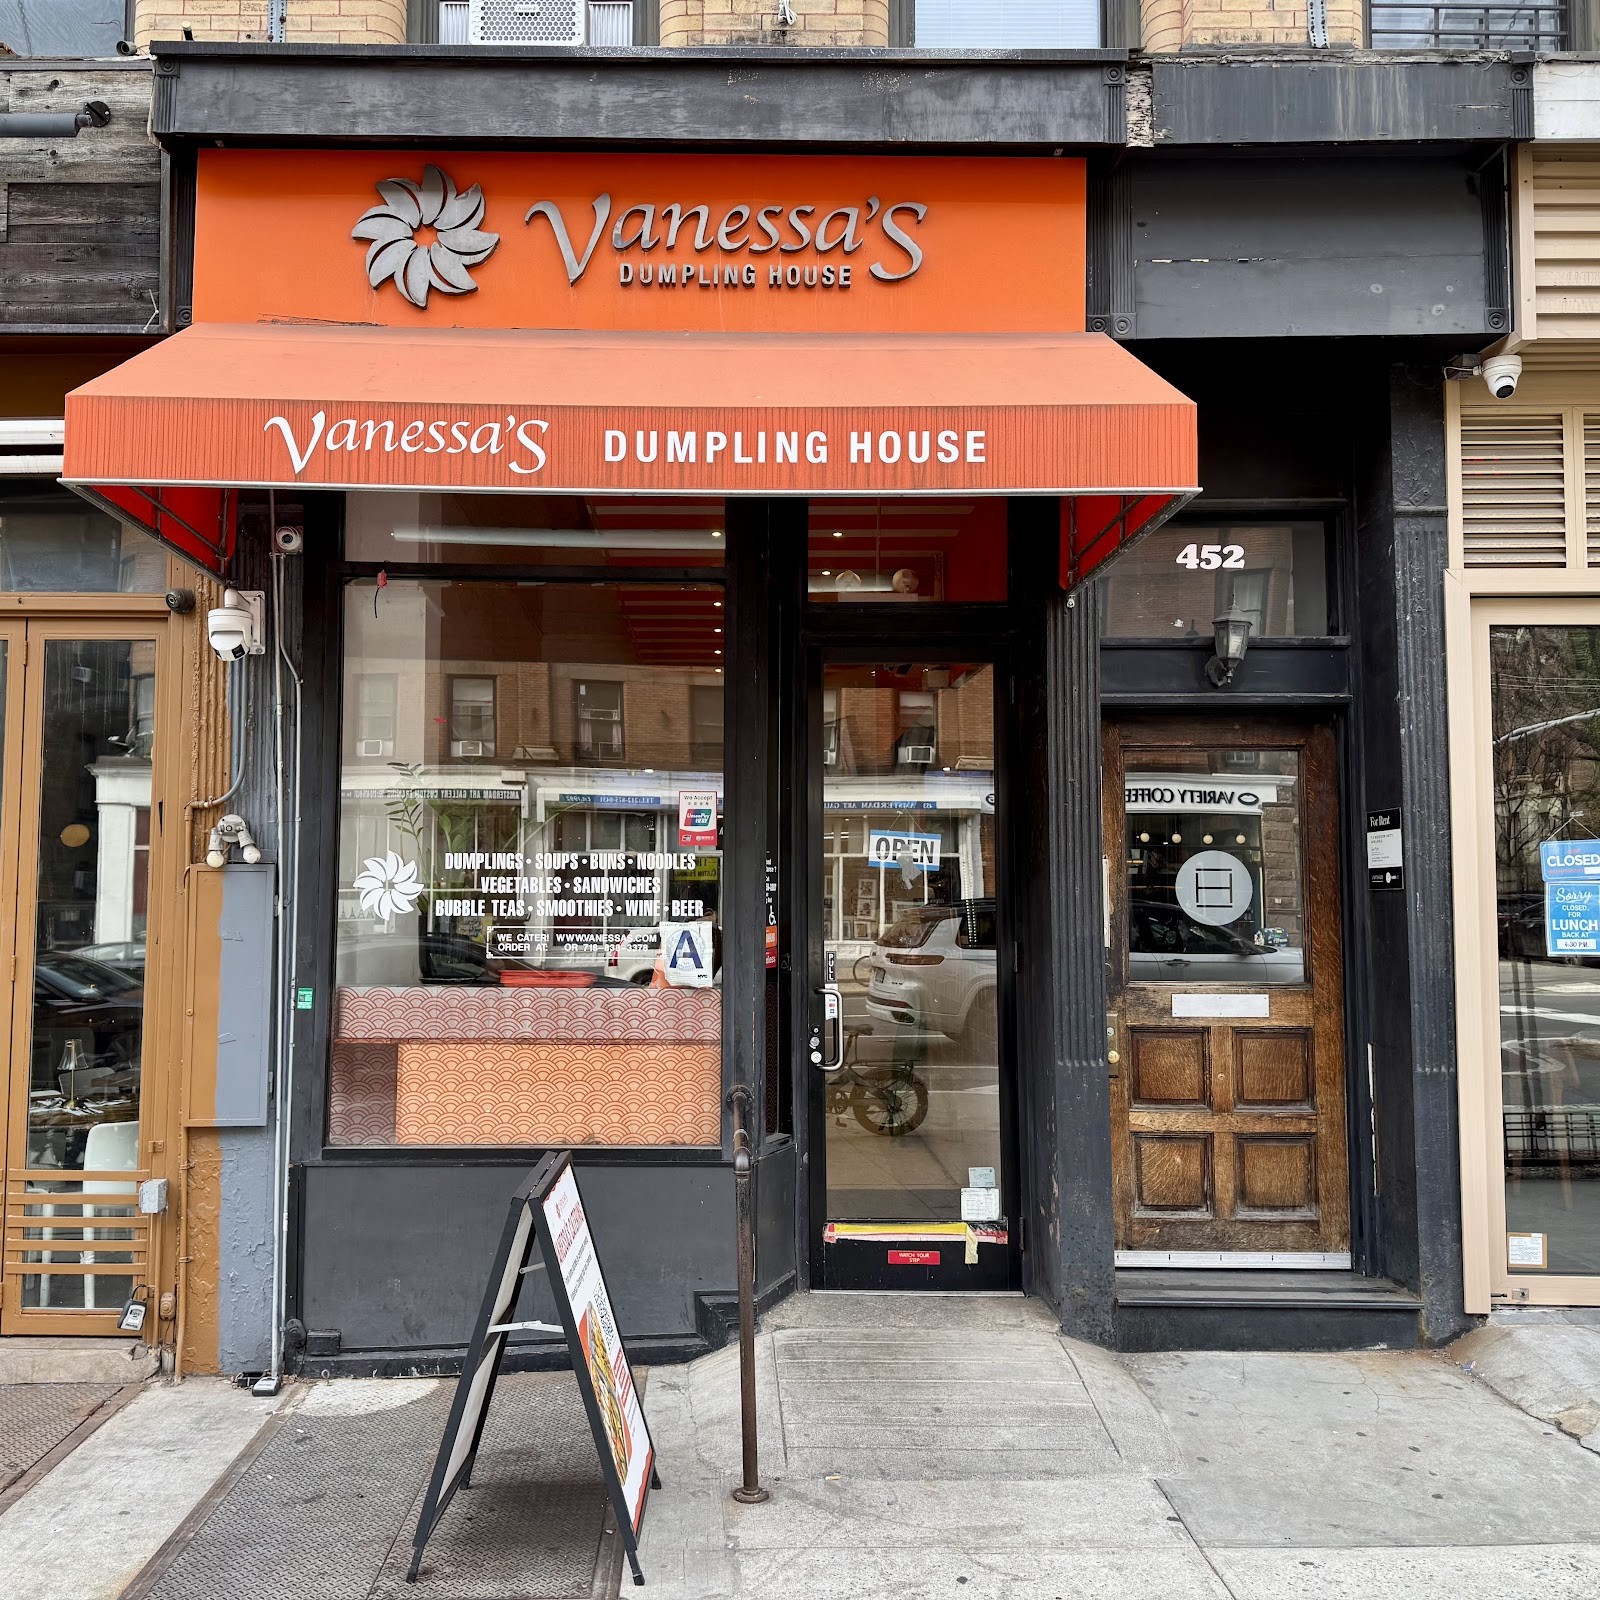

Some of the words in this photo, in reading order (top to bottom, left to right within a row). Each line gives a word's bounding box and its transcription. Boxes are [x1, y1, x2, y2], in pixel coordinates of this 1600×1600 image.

[619, 263, 757, 288] DUMPLING
[768, 265, 852, 288] HOUSE
[604, 430, 828, 464] DUMPLING
[850, 430, 988, 464] HOUSE
[1175, 543, 1246, 570] 452
[1370, 816, 1378, 827] For
[1379, 816, 1390, 826] Rent
[876, 837, 935, 863] OPEN
[445, 853, 523, 870] DUMPLINGS
[535, 853, 579, 870] SOUPS
[590, 853, 627, 870] BUNS
[637, 853, 696, 870] NOODLES
[1546, 854, 1600, 867] CLOSED
[481, 877, 562, 894] VEGETABLES
[573, 877, 661, 894] SANDWICHES
[1556, 887, 1593, 903] Sorry
[435, 900, 485, 917] BUBBLE
[491, 900, 525, 917] TEAS
[536, 900, 613, 917] SMOOTHIES
[625, 900, 660, 917] WINE
[671, 900, 703, 917] BEER
[1552, 919, 1599, 931] LUNCH
[497, 934, 509, 942] WE
[517, 934, 550, 942] CATER!
[498, 944, 531, 952] ORDER
[564, 944, 578, 952] OR
[669, 930, 704, 968] A
